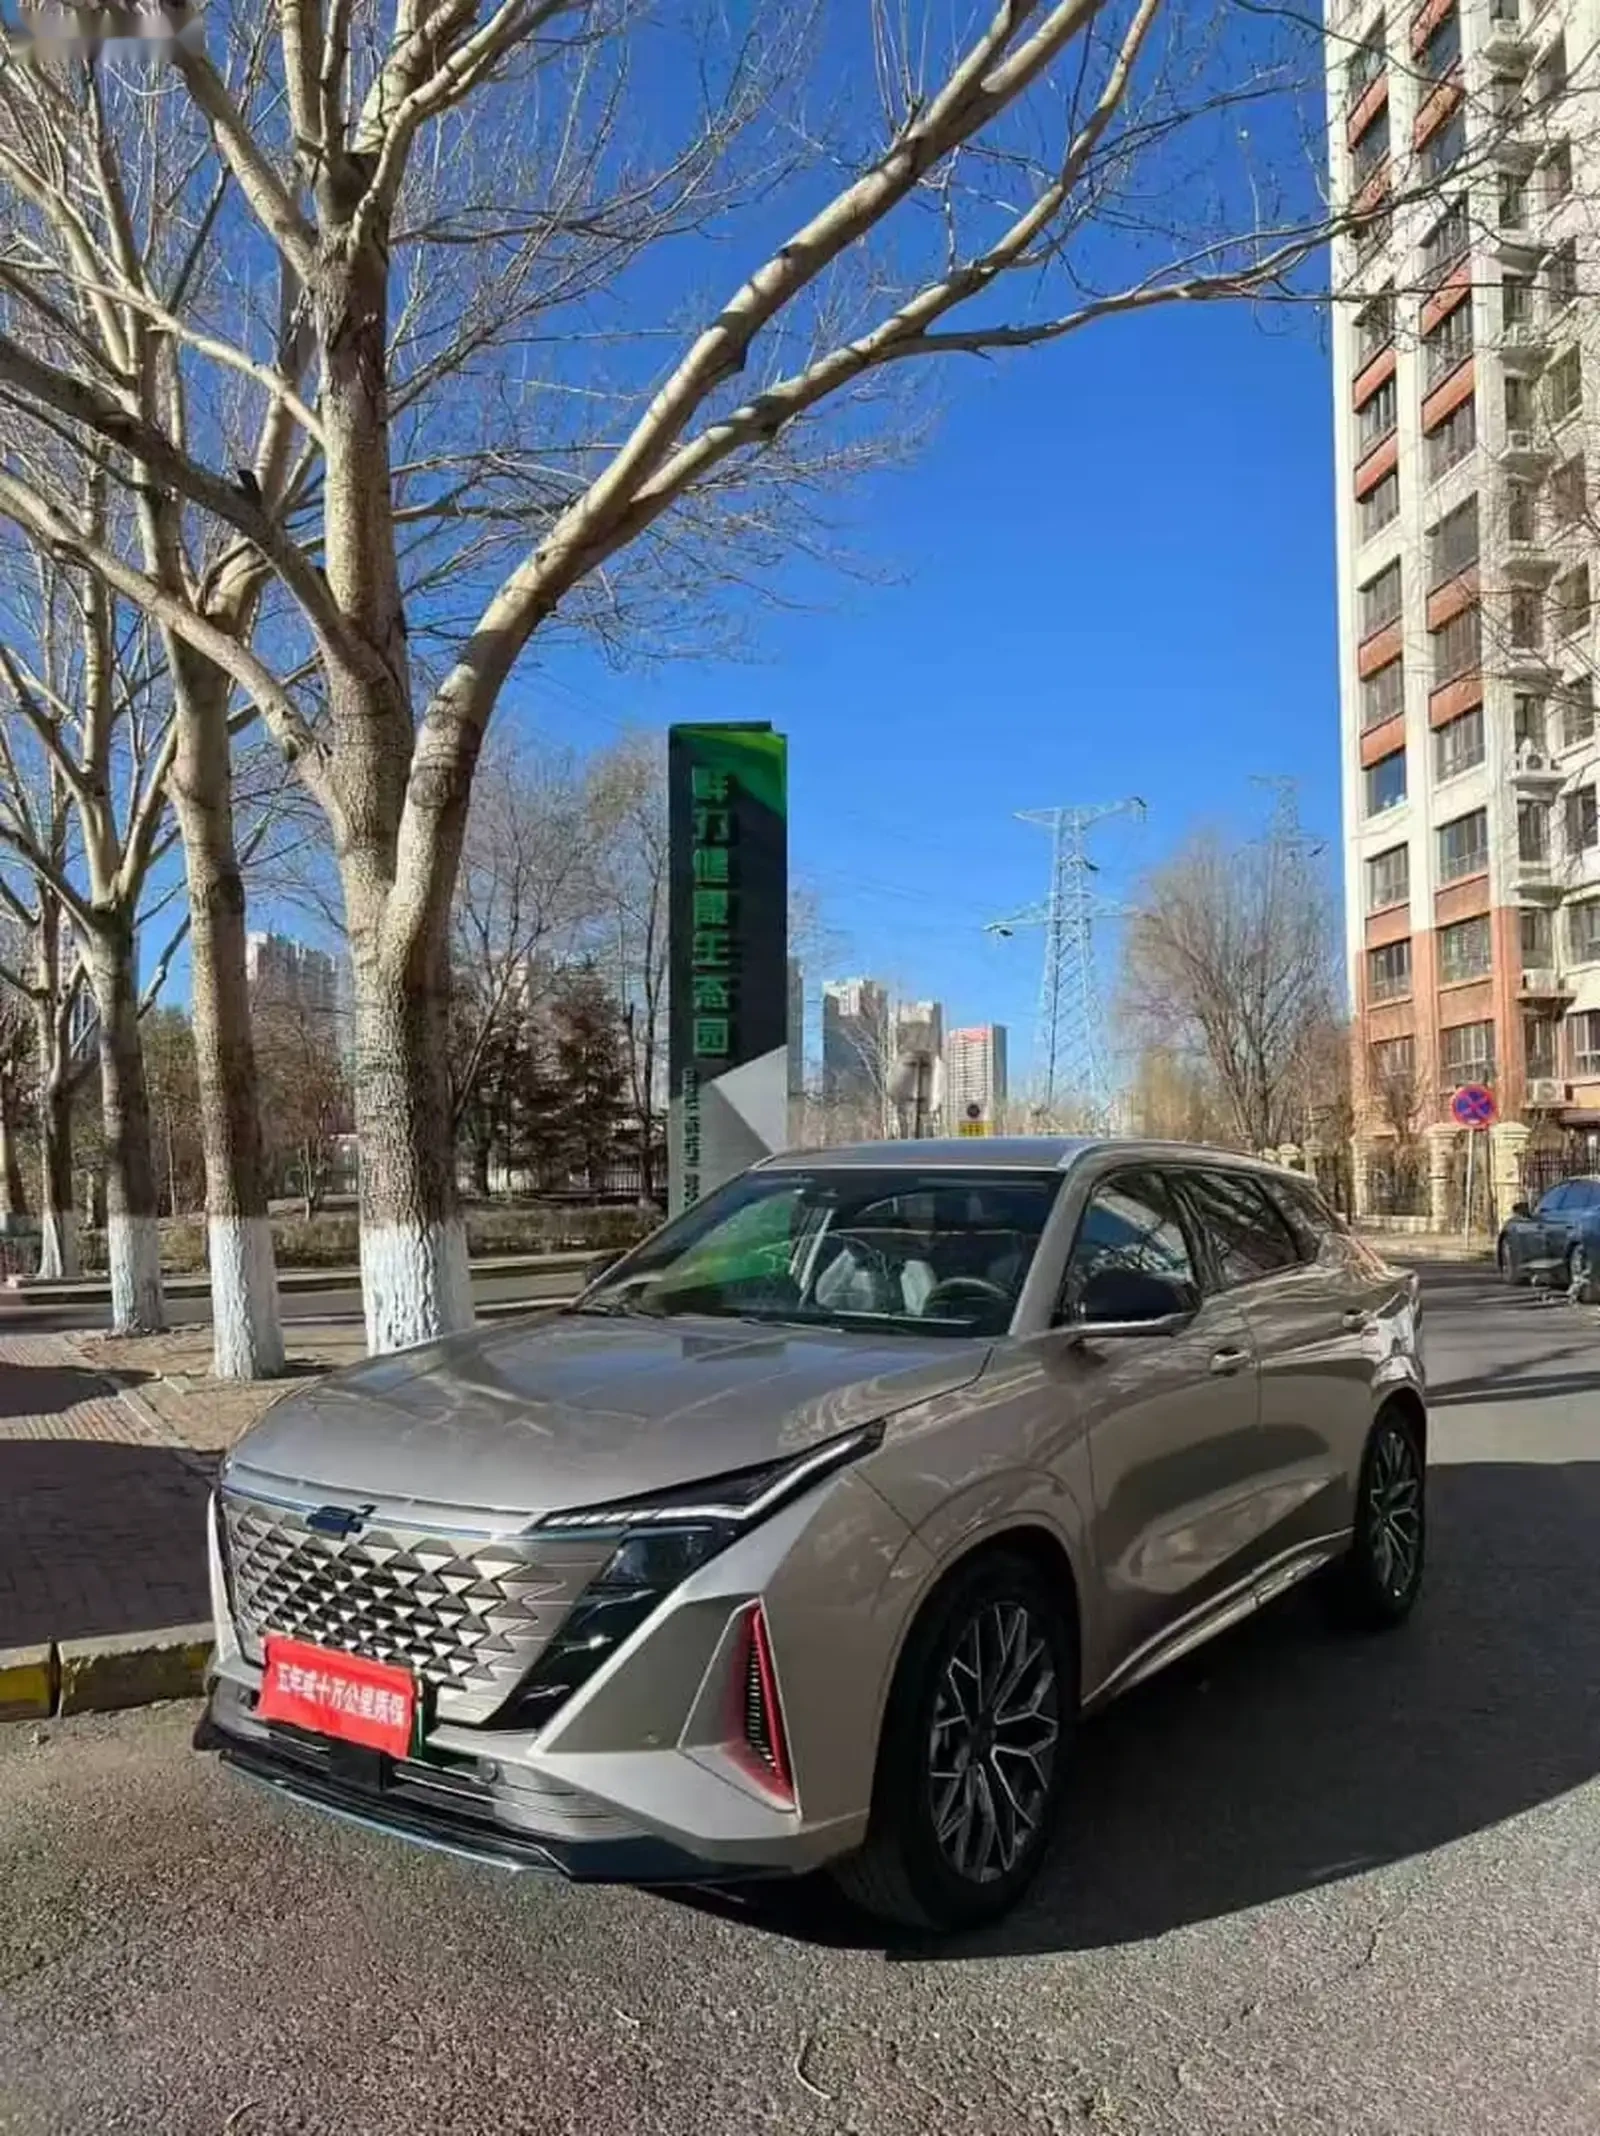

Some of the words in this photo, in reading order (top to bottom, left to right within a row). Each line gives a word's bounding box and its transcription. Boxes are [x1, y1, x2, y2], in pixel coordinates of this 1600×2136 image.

[276, 1663, 405, 1725] 五年或十万公里质保
